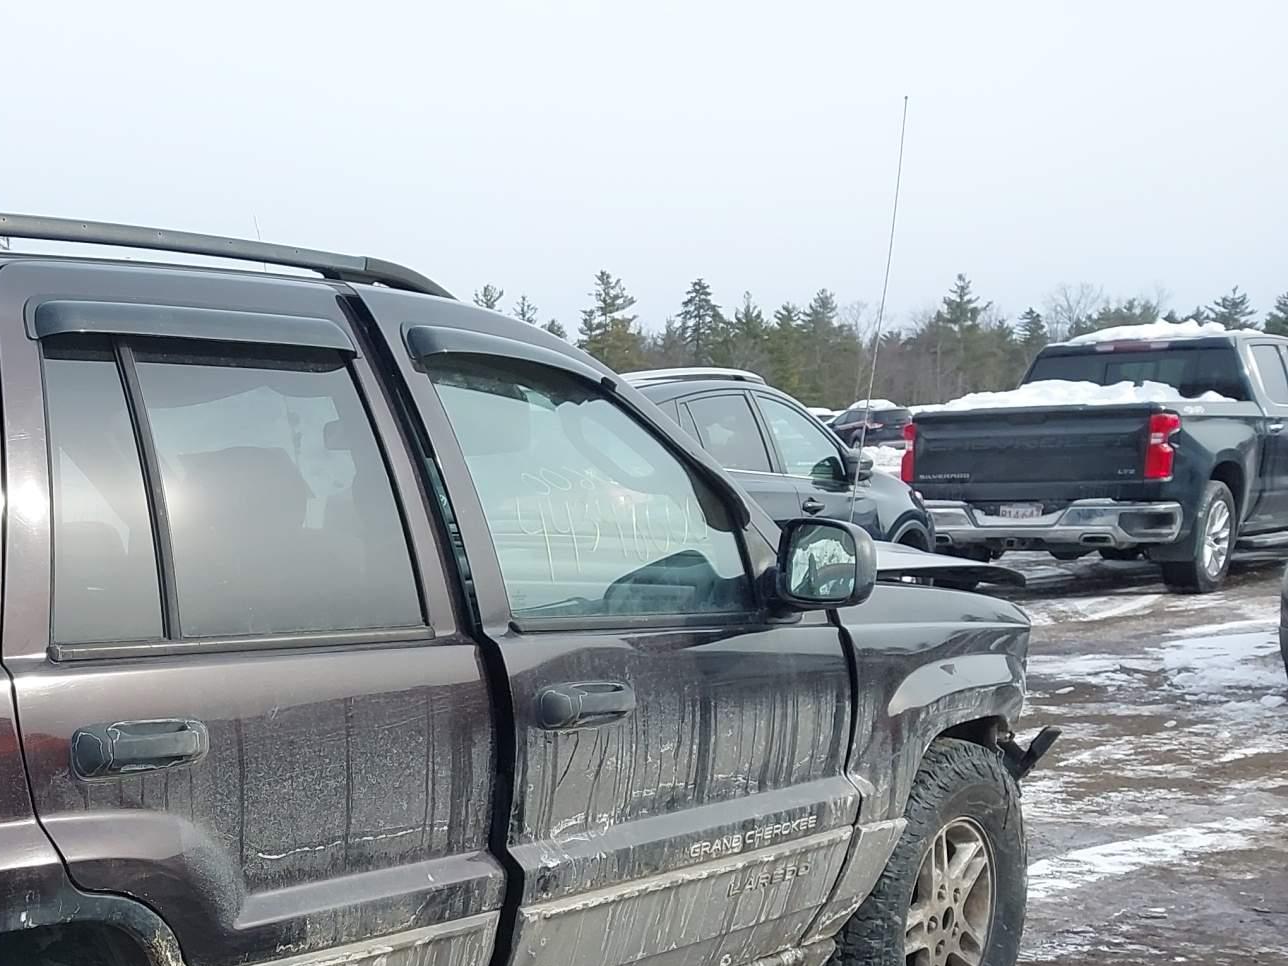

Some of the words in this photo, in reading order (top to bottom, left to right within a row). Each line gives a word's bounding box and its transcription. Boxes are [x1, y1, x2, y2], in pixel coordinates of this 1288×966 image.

[690, 834, 743, 858] GRAND
[745, 815, 817, 844] CHEROKEE
[727, 862, 810, 897] LAREDO
